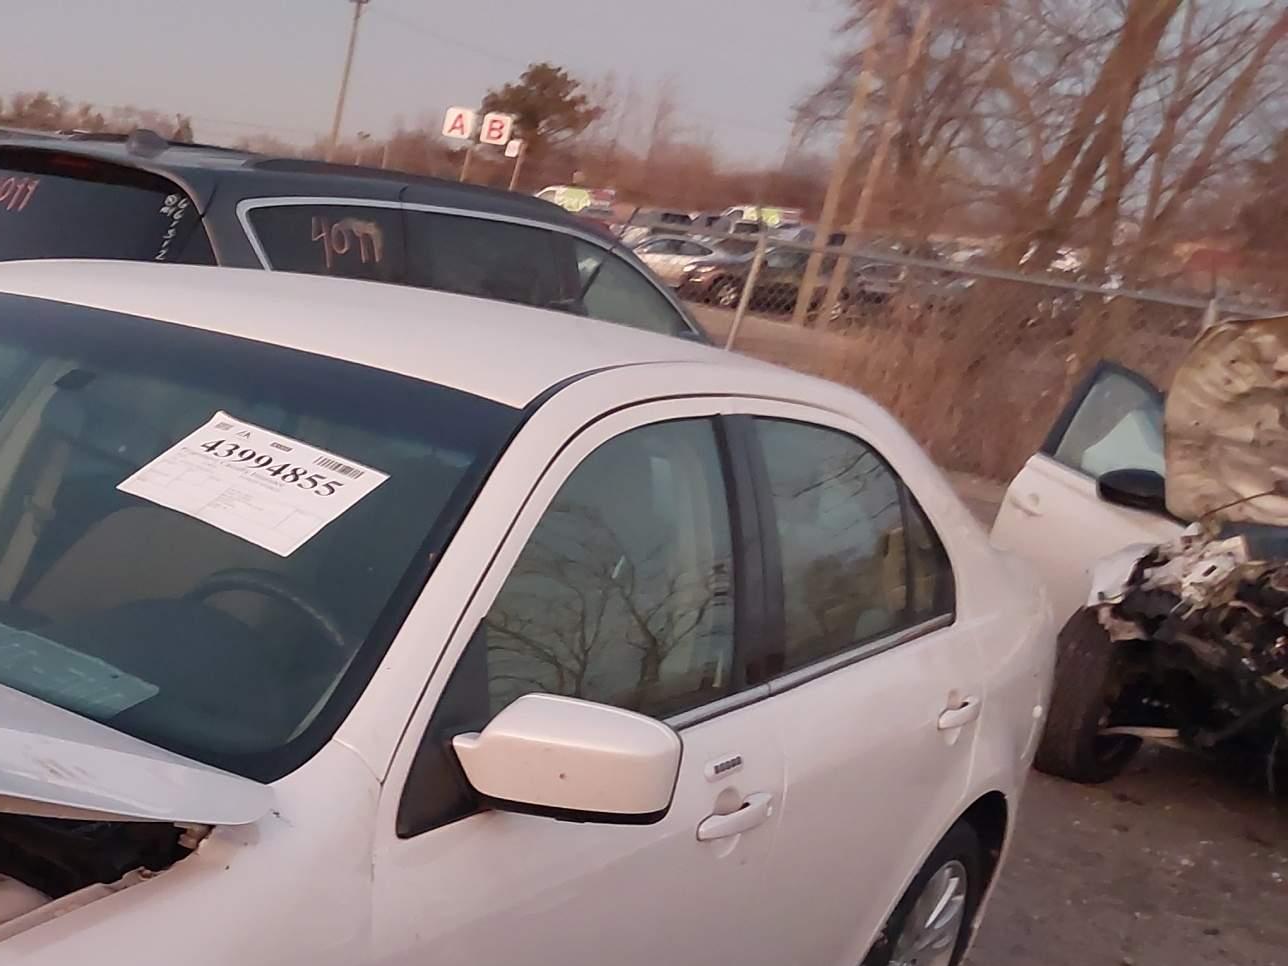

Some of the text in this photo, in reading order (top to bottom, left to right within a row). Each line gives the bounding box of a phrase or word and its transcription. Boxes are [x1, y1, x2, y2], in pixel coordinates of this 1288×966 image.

[447, 113, 465, 136] A
[487, 119, 505, 141] B
[200, 438, 344, 497] 43994855
